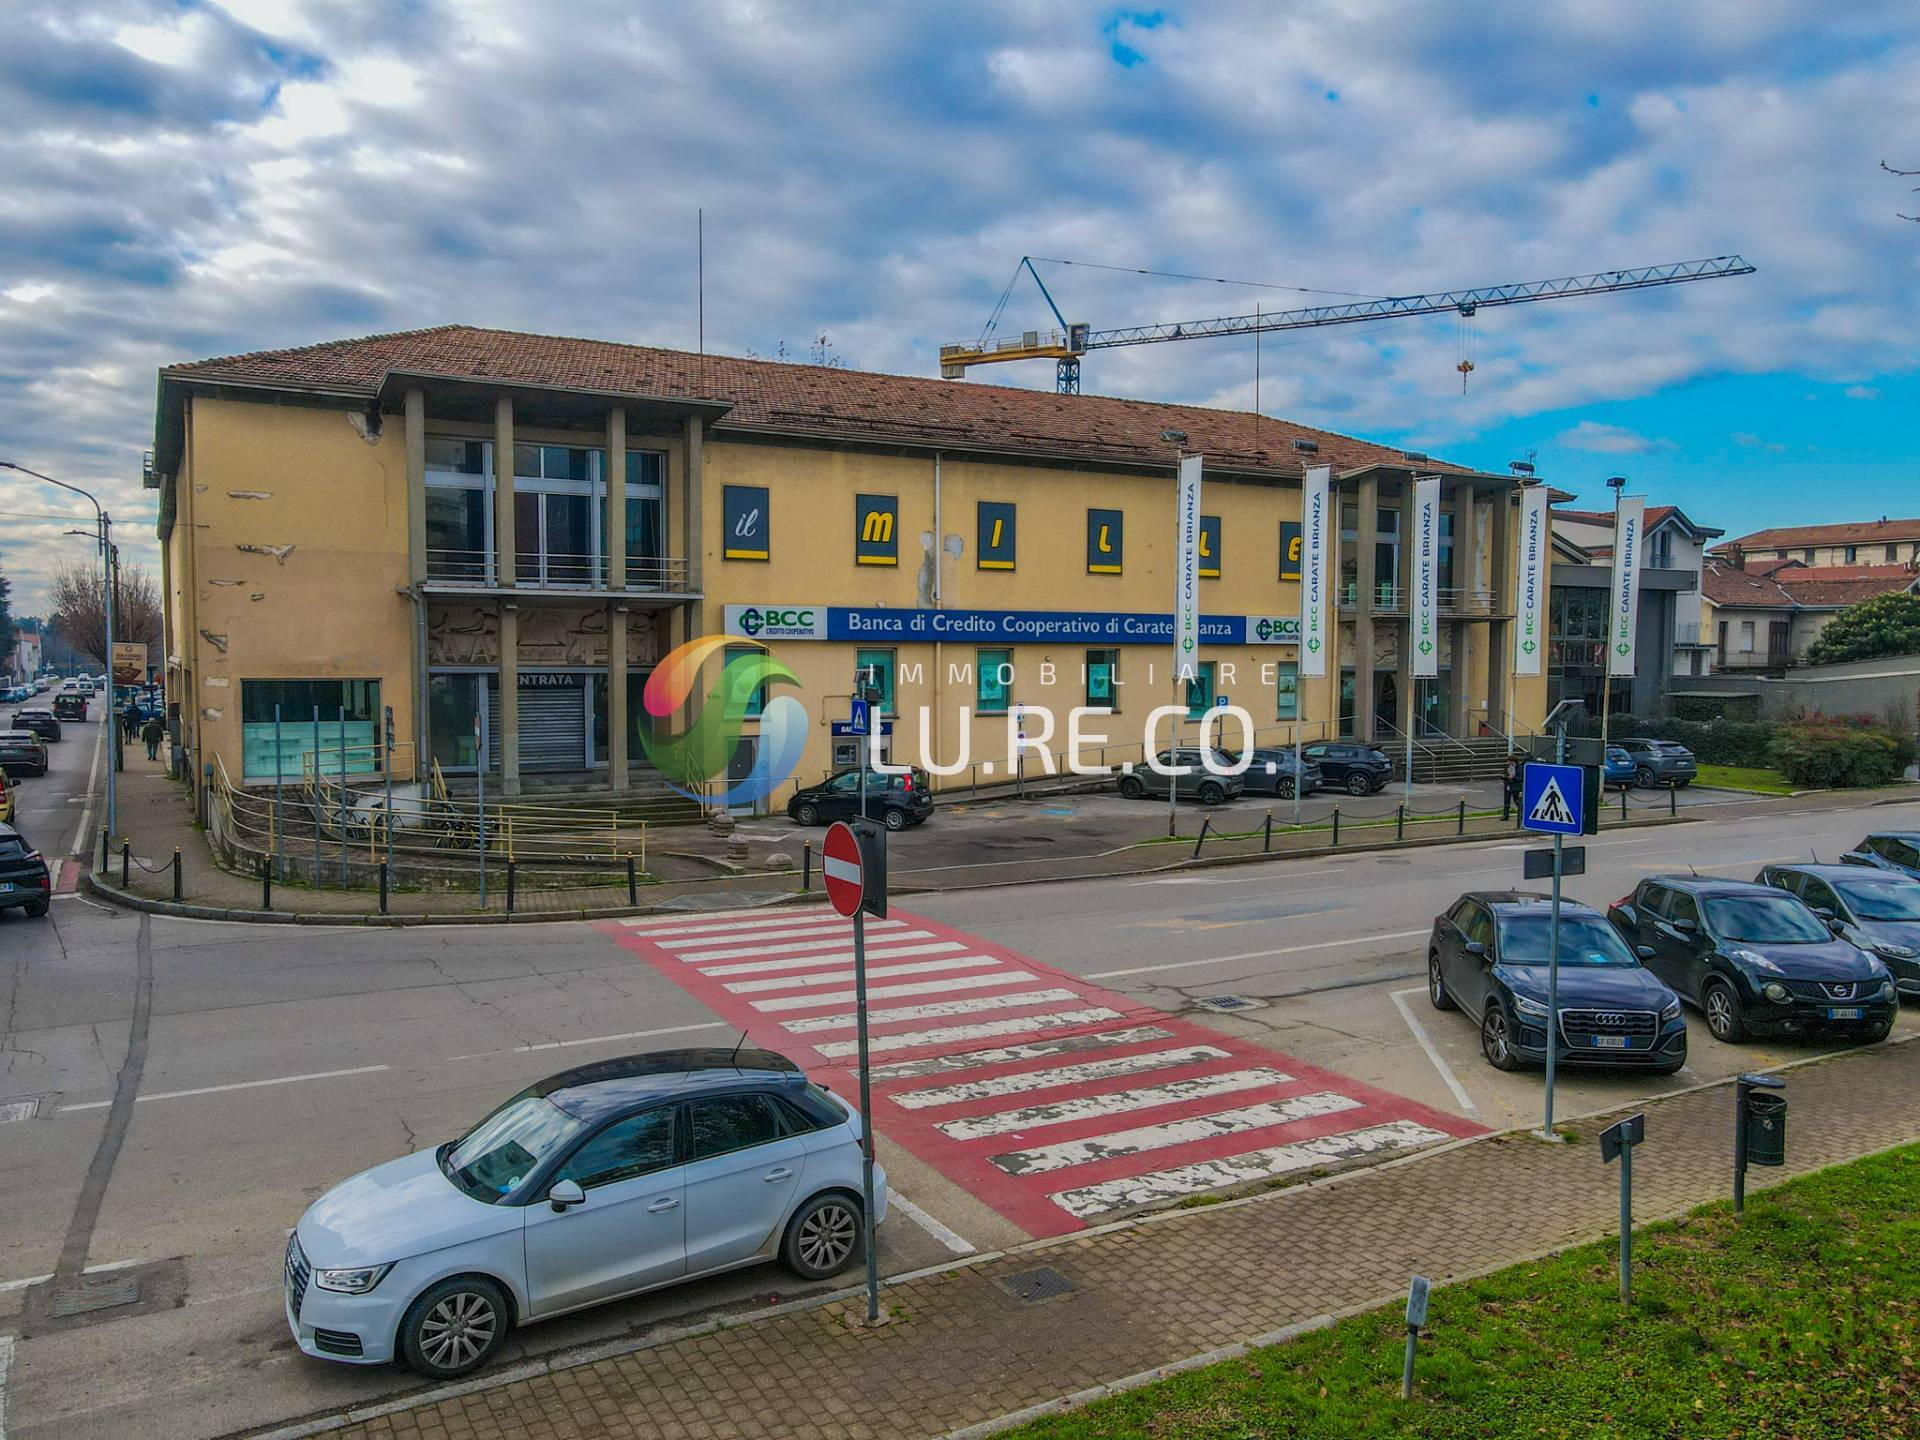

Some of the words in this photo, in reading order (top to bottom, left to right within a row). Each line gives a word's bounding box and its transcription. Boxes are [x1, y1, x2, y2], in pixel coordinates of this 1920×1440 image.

[1186, 483, 1194, 544] BRIANZA
[1312, 491, 1321, 550] BRIANZA
[1423, 502, 1431, 557] BRIANZA
[1529, 509, 1539, 561] BRIANZA
[1624, 518, 1634, 568] BRIANZA
[1185, 548, 1193, 600] CARATE
[1311, 553, 1319, 603] CARATE
[1422, 559, 1430, 607] CARATE
[1526, 564, 1536, 609] CARATE
[1621, 570, 1631, 613] CARATE
[765, 610, 814, 627] BCC
[848, 612, 903, 631] Banca
[910, 614, 925, 631] di
[932, 614, 996, 632] Credito
[1002, 615, 1100, 636] Cooperativo
[1105, 617, 1119, 633] di
[1124, 618, 1173, 634] Carate
[1184, 604, 1193, 631] BCC
[1310, 607, 1318, 632] BCC
[1421, 610, 1430, 635] BCC
[1525, 612, 1534, 635] BCC
[1620, 615, 1629, 639] BCC
[519, 674, 574, 685] NTRATA
